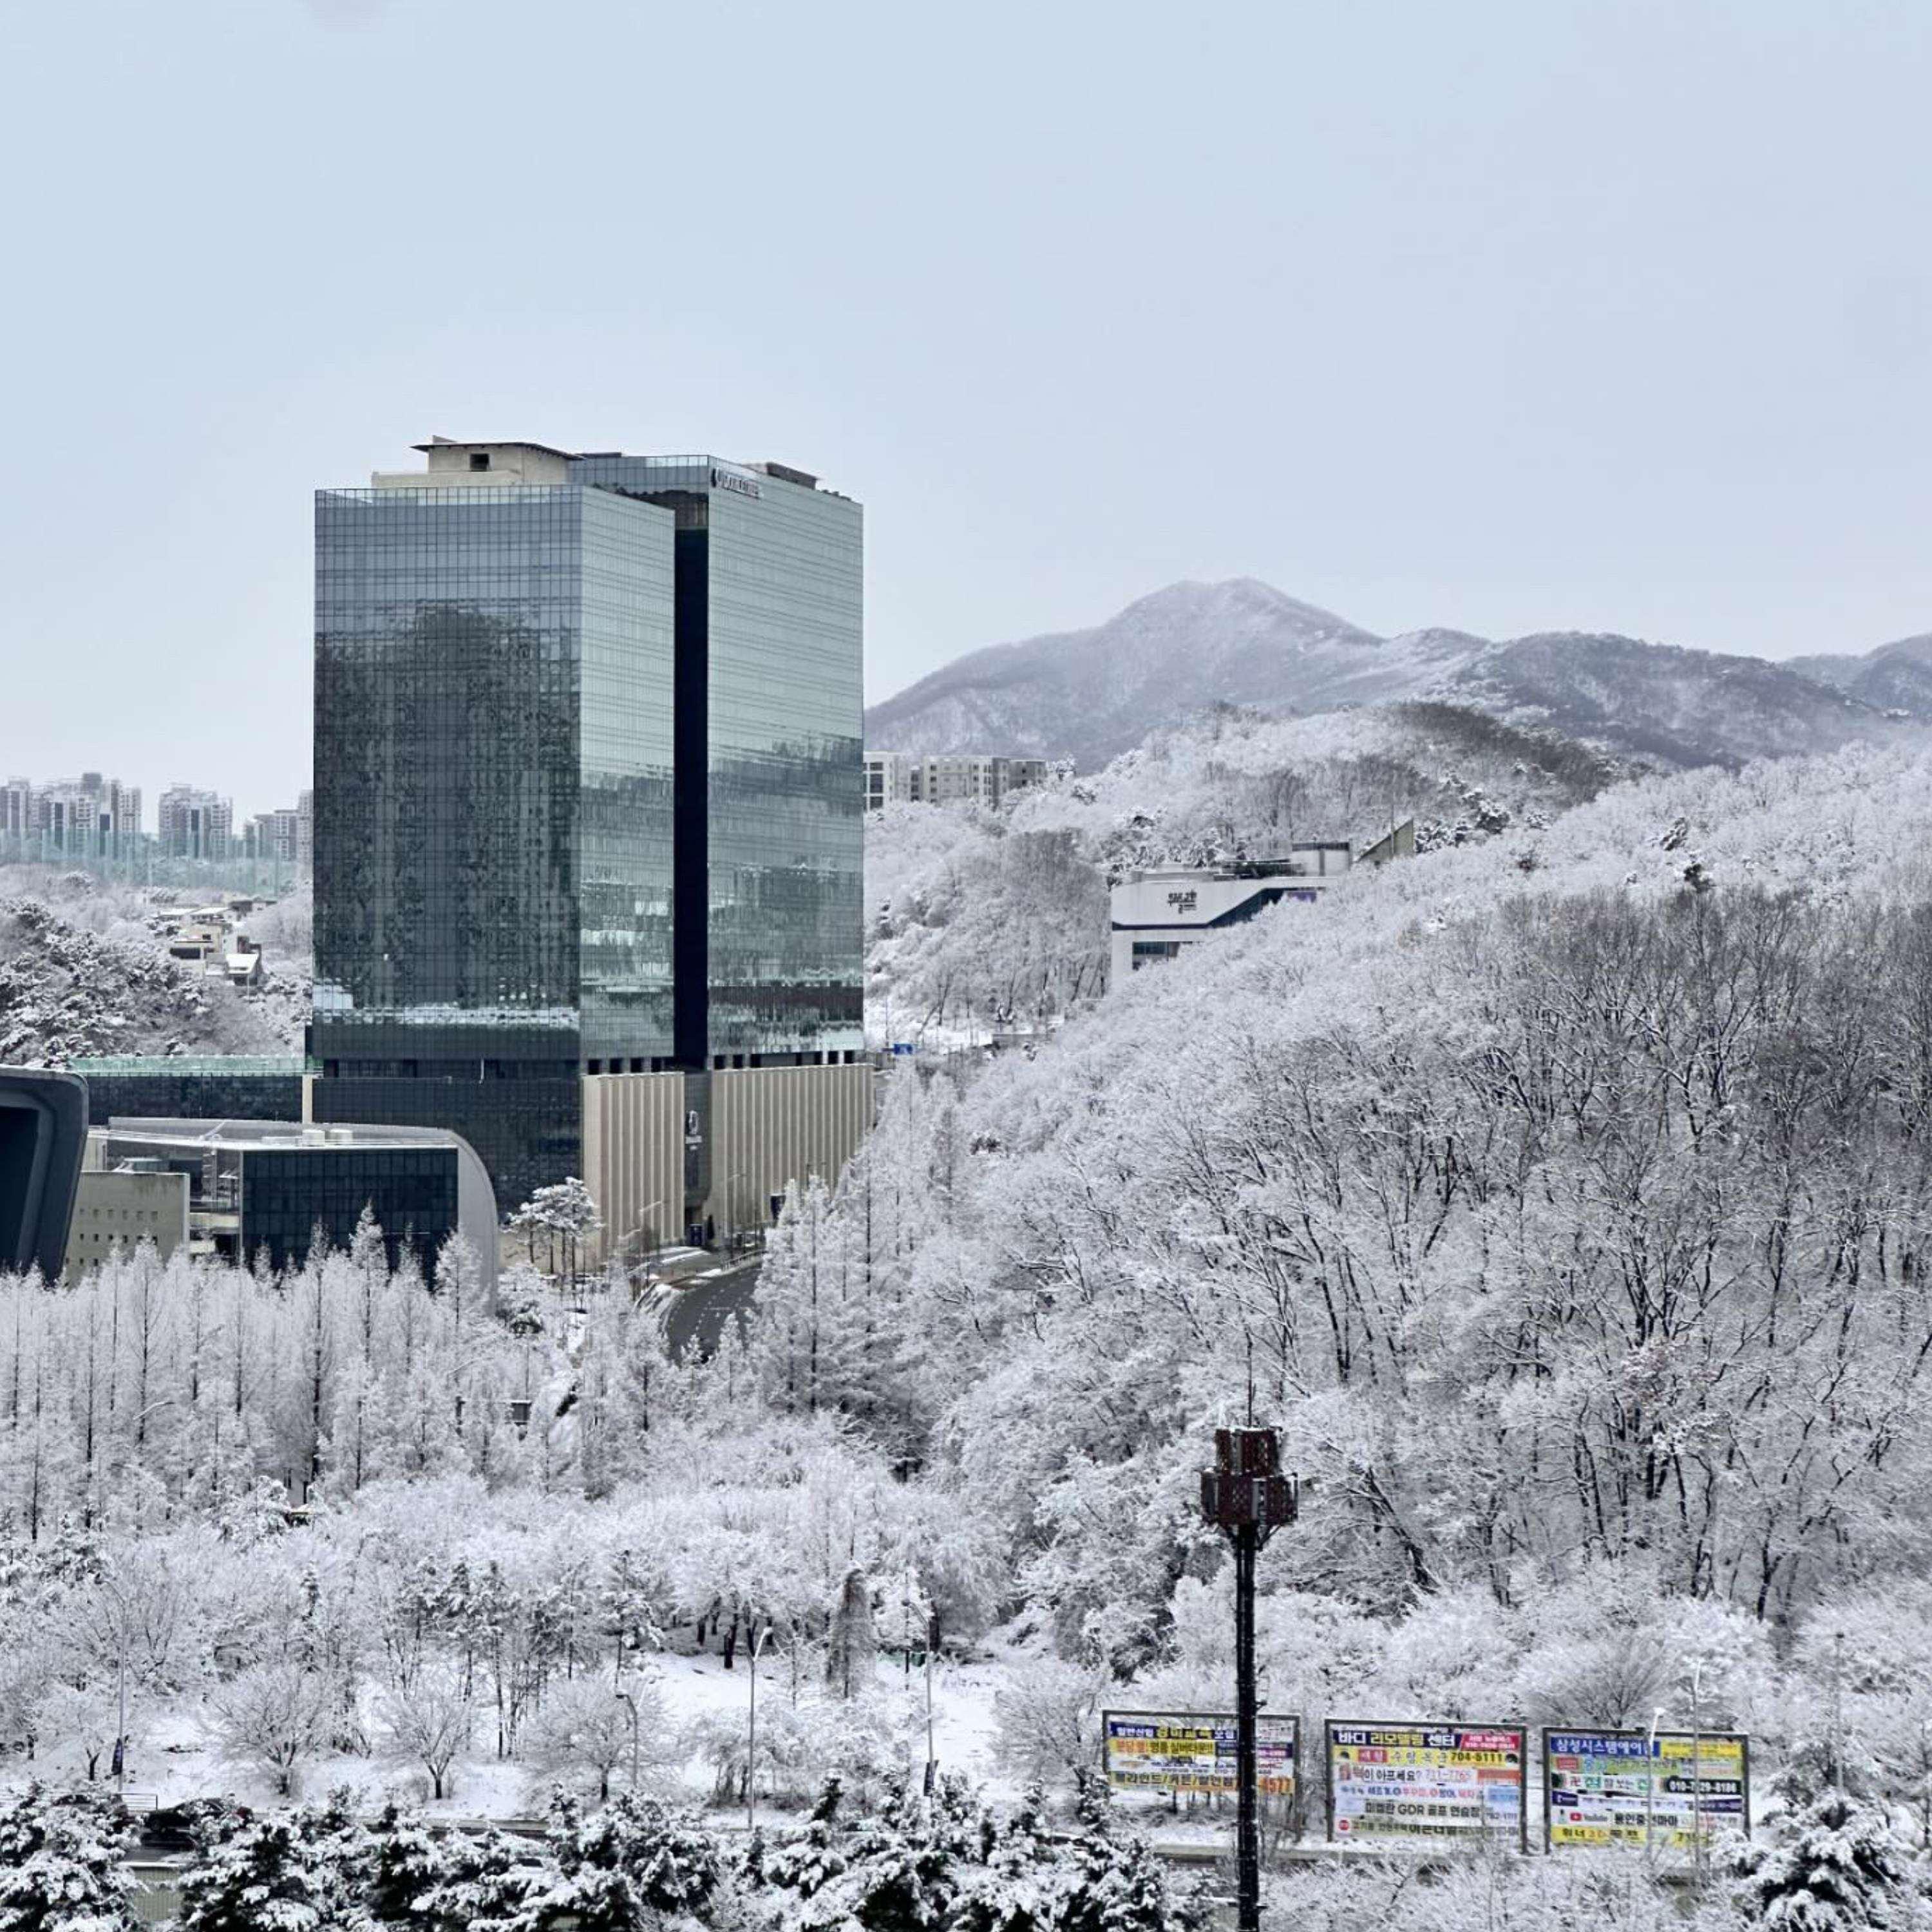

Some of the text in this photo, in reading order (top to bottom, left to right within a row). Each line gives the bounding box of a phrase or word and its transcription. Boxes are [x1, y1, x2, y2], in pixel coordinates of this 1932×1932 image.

[1338, 1732, 1455, 1746] 바디 리모델링 센터
[1397, 1804, 1425, 1815] GDR
[1428, 1804, 1446, 1816] 골프
[1450, 1806, 1481, 1817] 연습장
